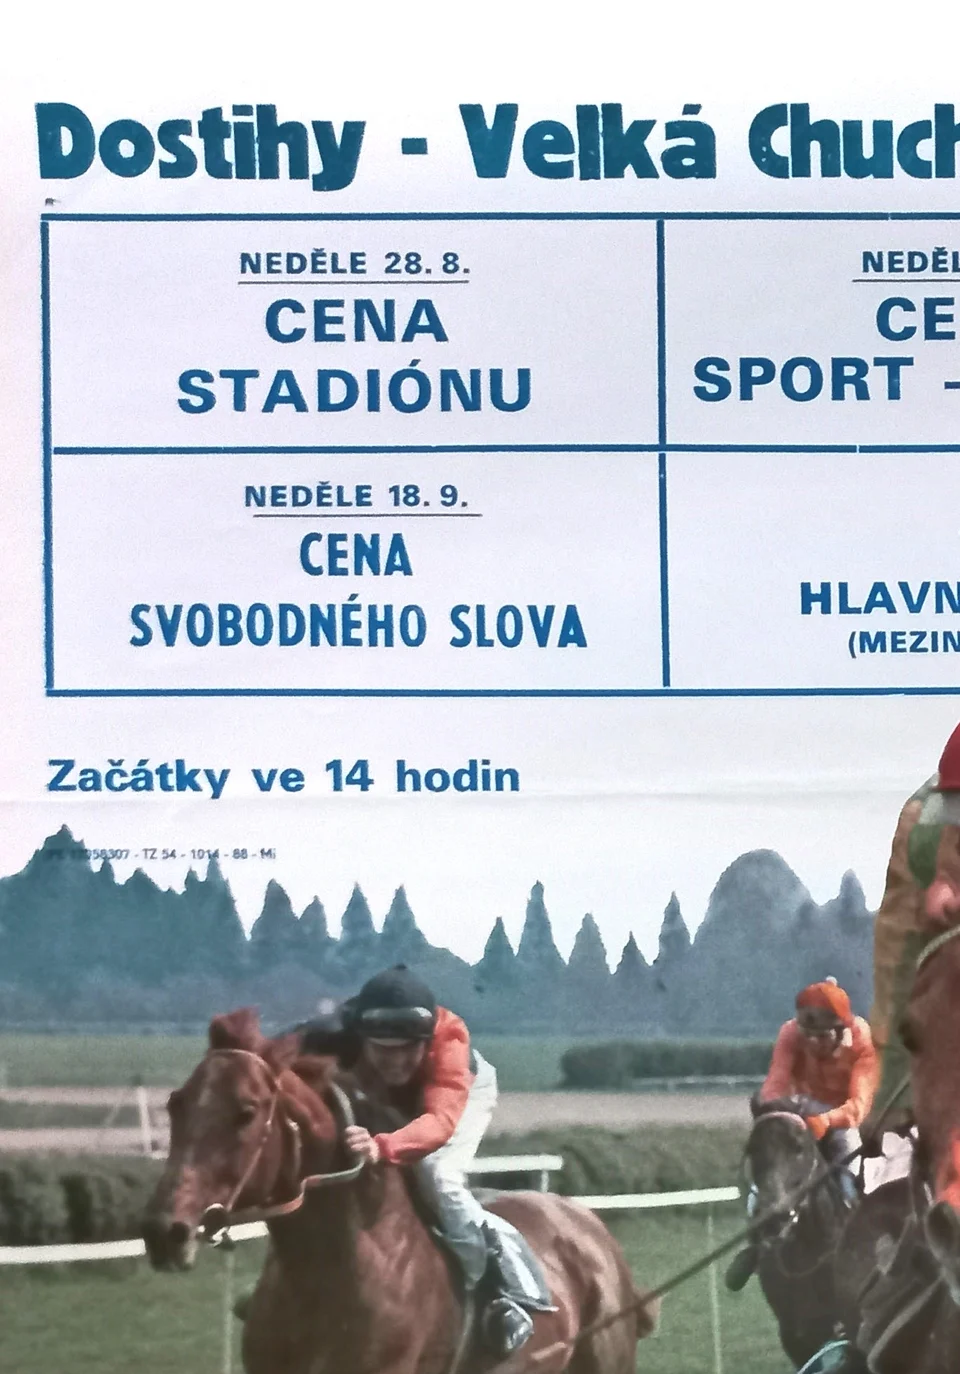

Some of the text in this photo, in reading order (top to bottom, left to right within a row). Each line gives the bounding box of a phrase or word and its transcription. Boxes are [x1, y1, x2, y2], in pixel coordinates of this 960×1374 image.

[34, 102, 367, 193] Dostihy
[458, 102, 717, 182] Velká
[240, 247, 367, 275] NEDĚLE
[265, 298, 449, 344] CENA
[177, 358, 531, 415] STADIÓNU
[693, 356, 914, 403] SPORT
[245, 481, 373, 508] NEDĚLE
[299, 531, 413, 577] CENA
[129, 593, 588, 649] SVOBODNÉHO SLOVA
[46, 758, 520, 800] Začátky ve 14 hodin
[142, 848, 158, 859] TZ
[162, 848, 176, 859] 54
